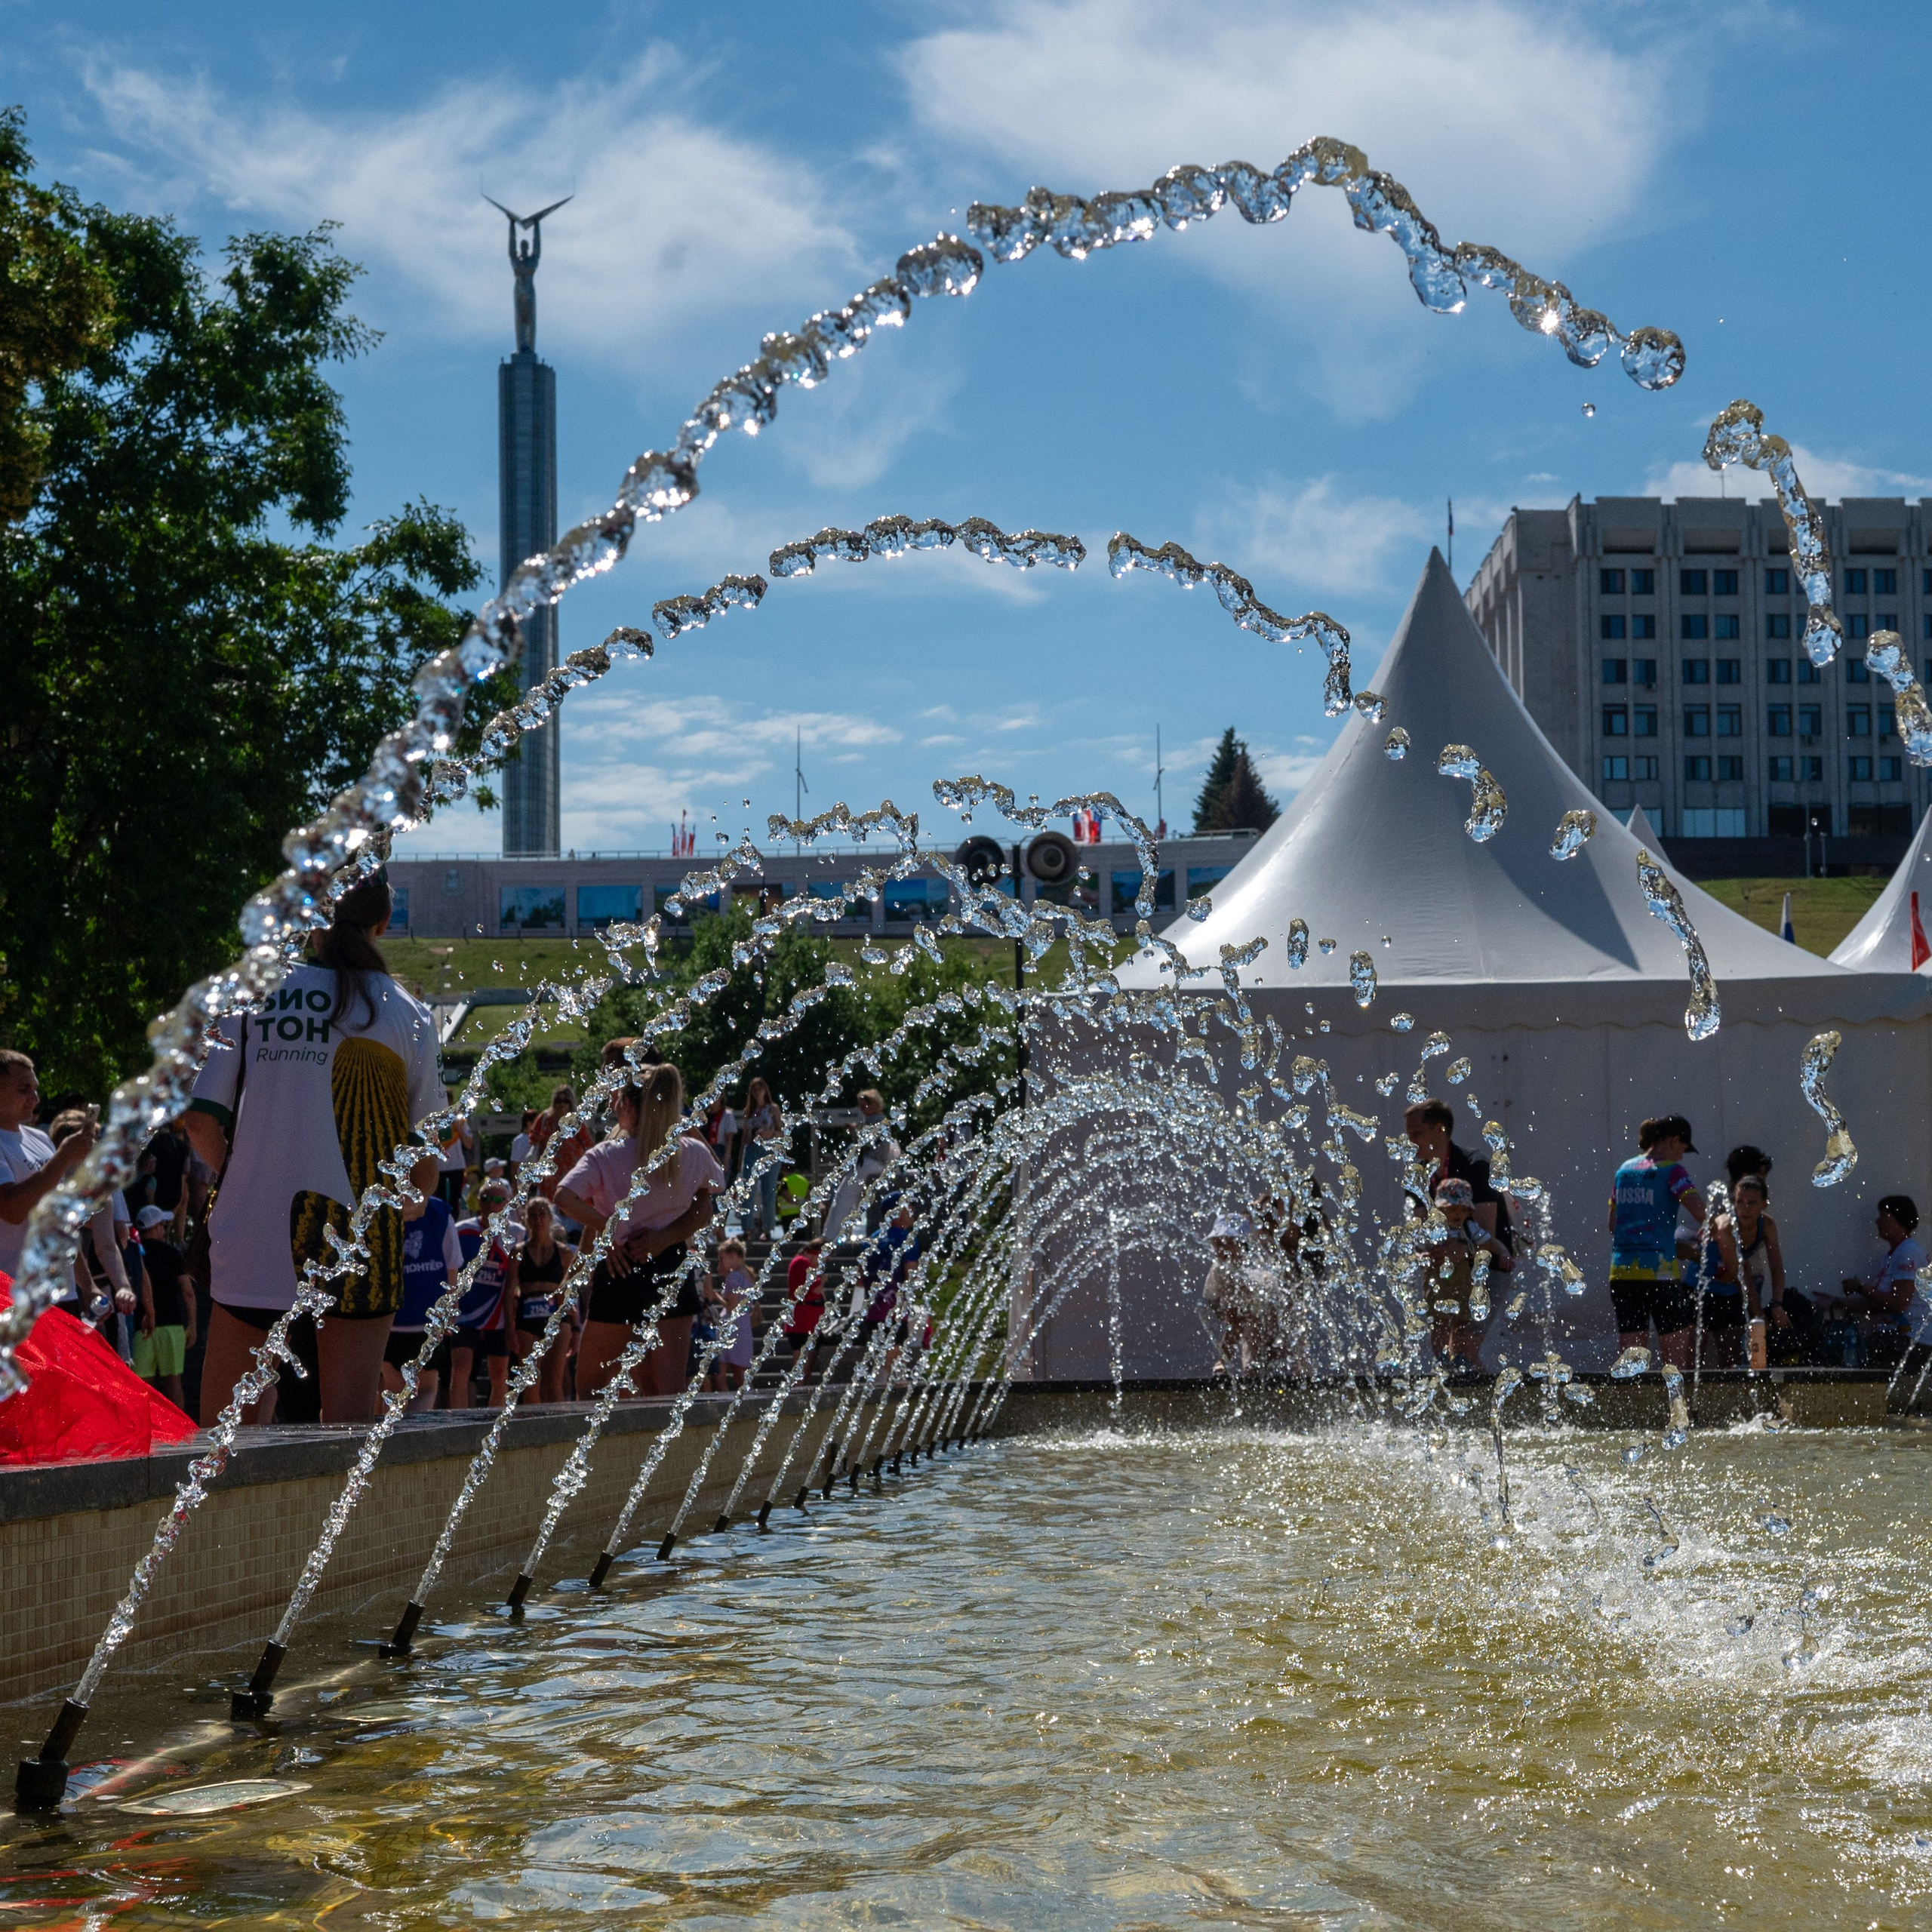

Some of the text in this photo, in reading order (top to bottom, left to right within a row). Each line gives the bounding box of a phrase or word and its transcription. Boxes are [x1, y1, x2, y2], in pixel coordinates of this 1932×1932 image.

[254, 1015, 330, 1044] ТОН
[257, 1046, 328, 1066] Running
[1616, 1187, 1654, 1206] USSIA
